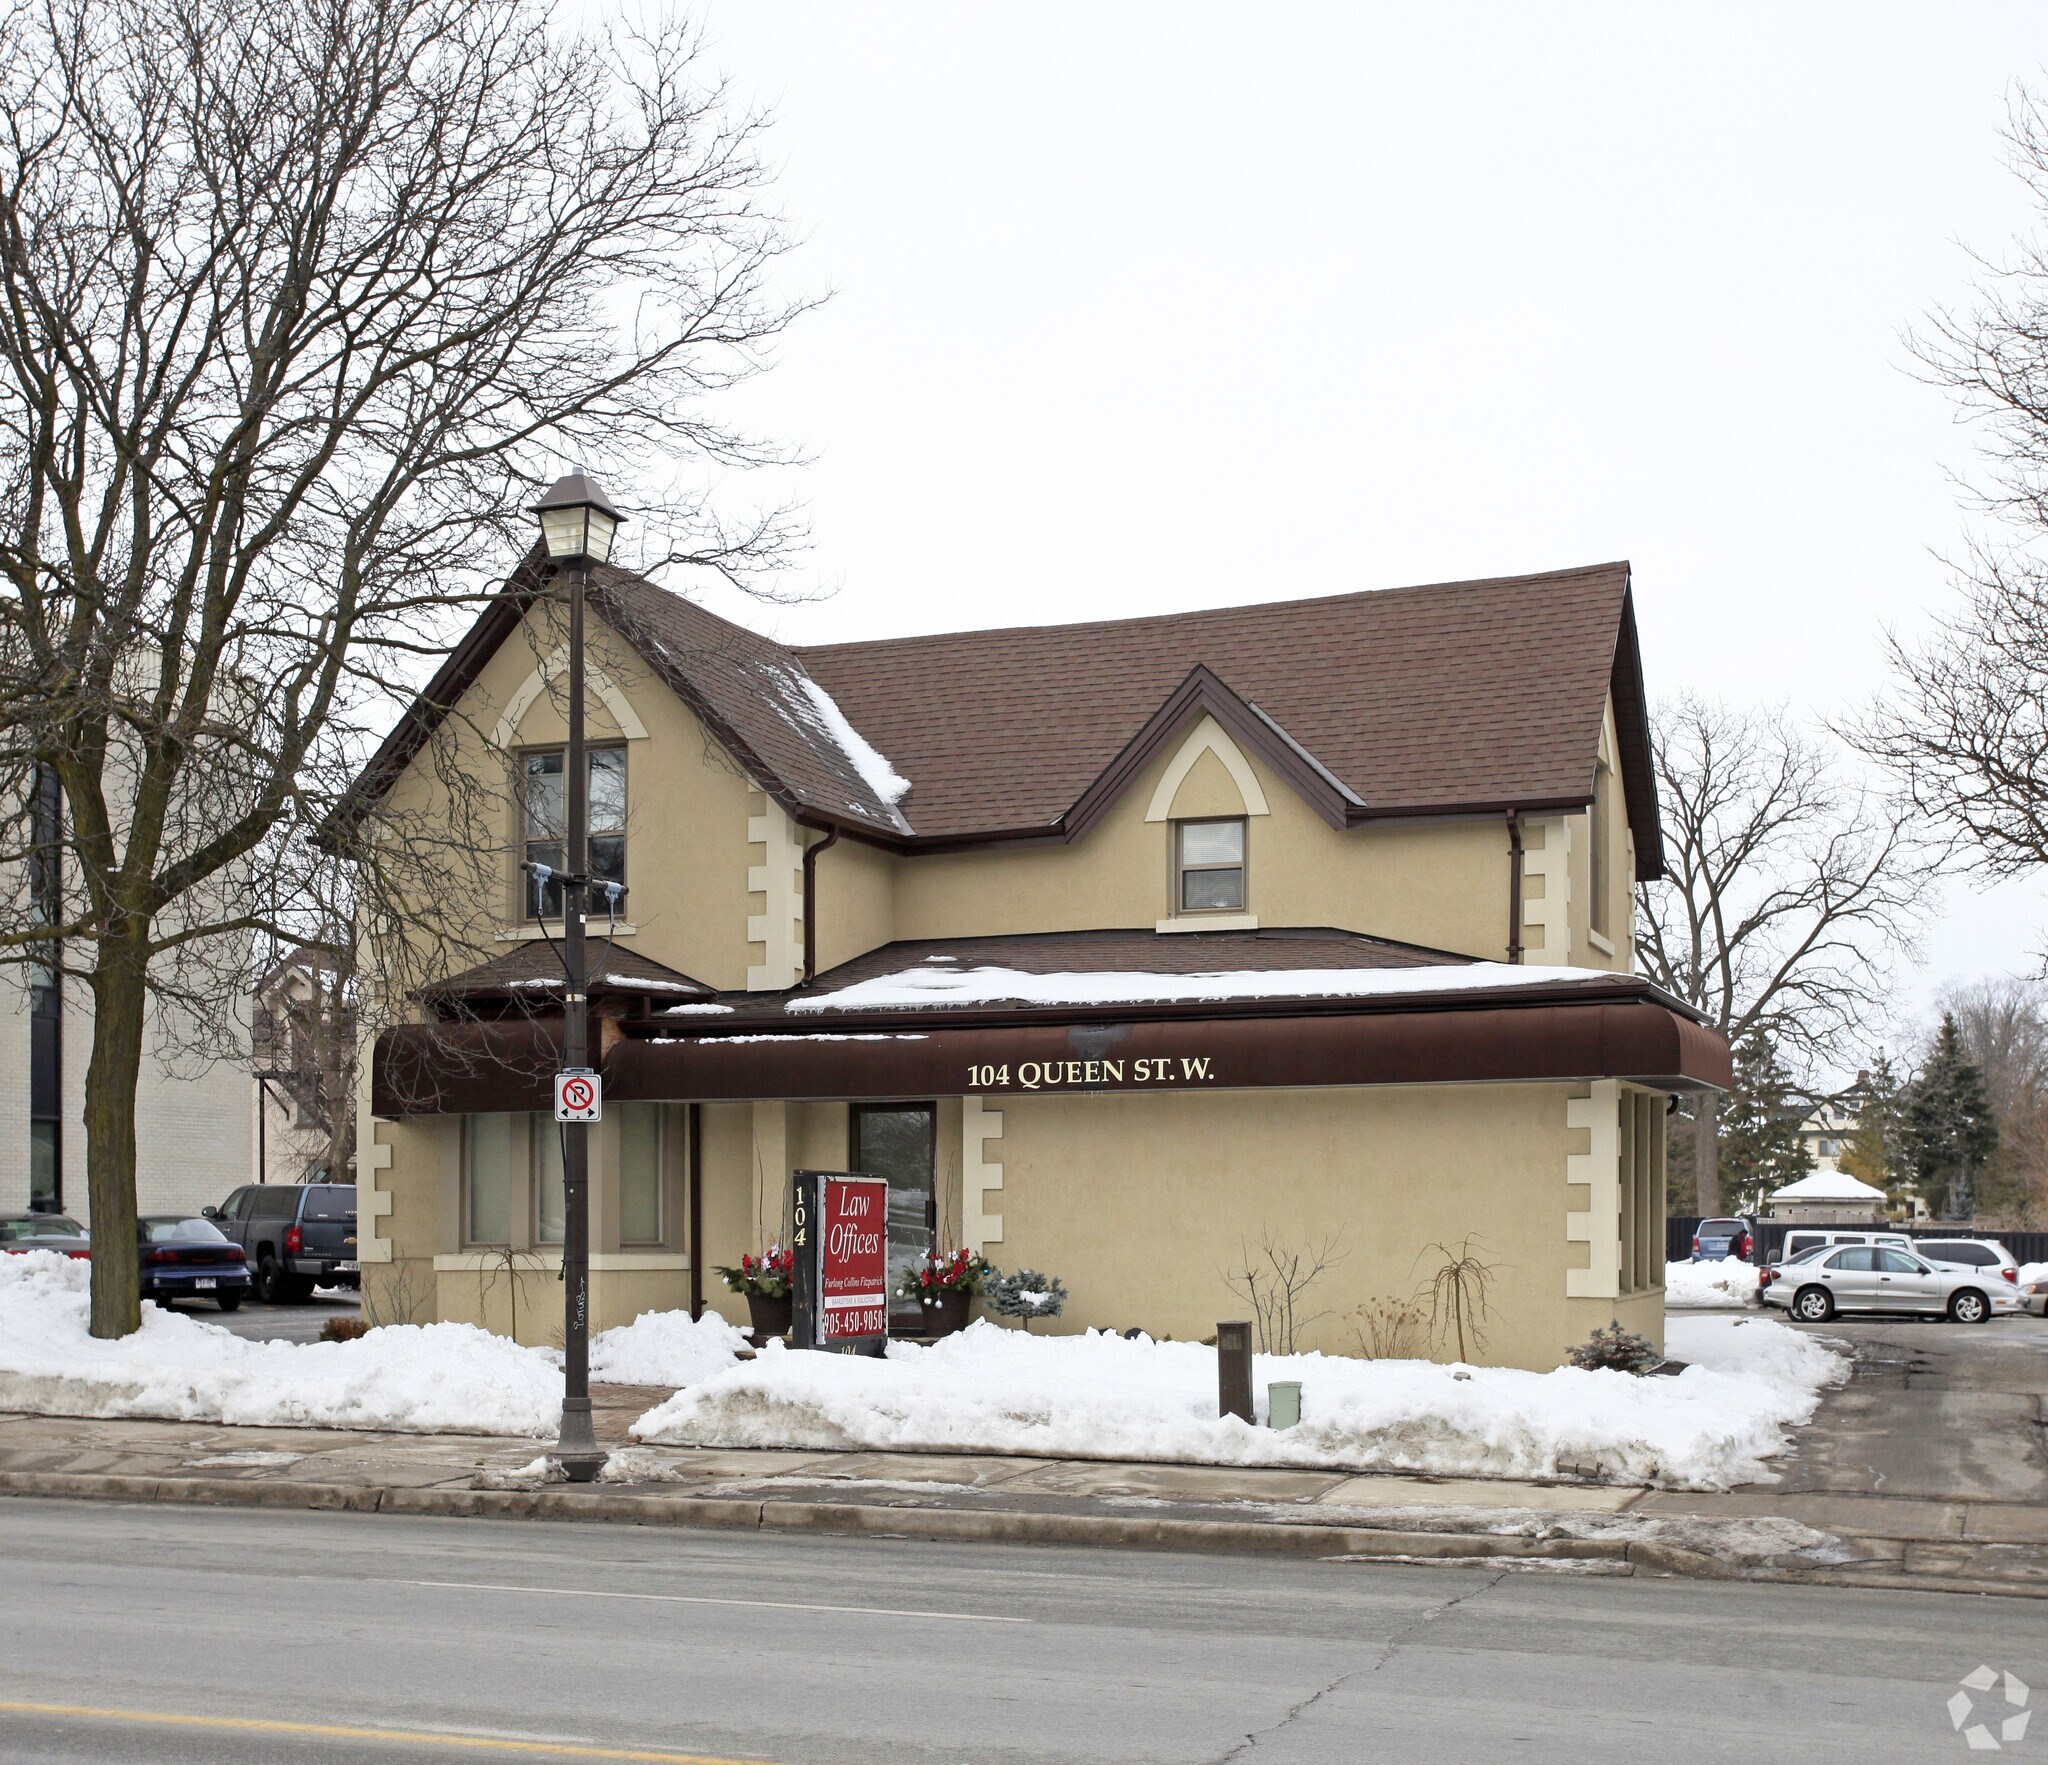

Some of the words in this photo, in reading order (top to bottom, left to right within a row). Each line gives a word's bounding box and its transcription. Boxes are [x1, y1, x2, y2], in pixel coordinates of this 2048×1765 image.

[967, 1064, 1010, 1087] 104
[1018, 1060, 1125, 1090] QUEEN
[1134, 1058, 1175, 1081] ST.
[1180, 1057, 1215, 1080] W.
[794, 1186, 807, 1247] 104
[838, 1185, 870, 1217] Law
[829, 1222, 879, 1264] Offices
[825, 1278, 843, 1290] Furlong
[844, 1277, 859, 1287] Collins
[860, 1276, 882, 1288] Fitzpatrick
[824, 1309, 883, 1335] 905-450-9050
